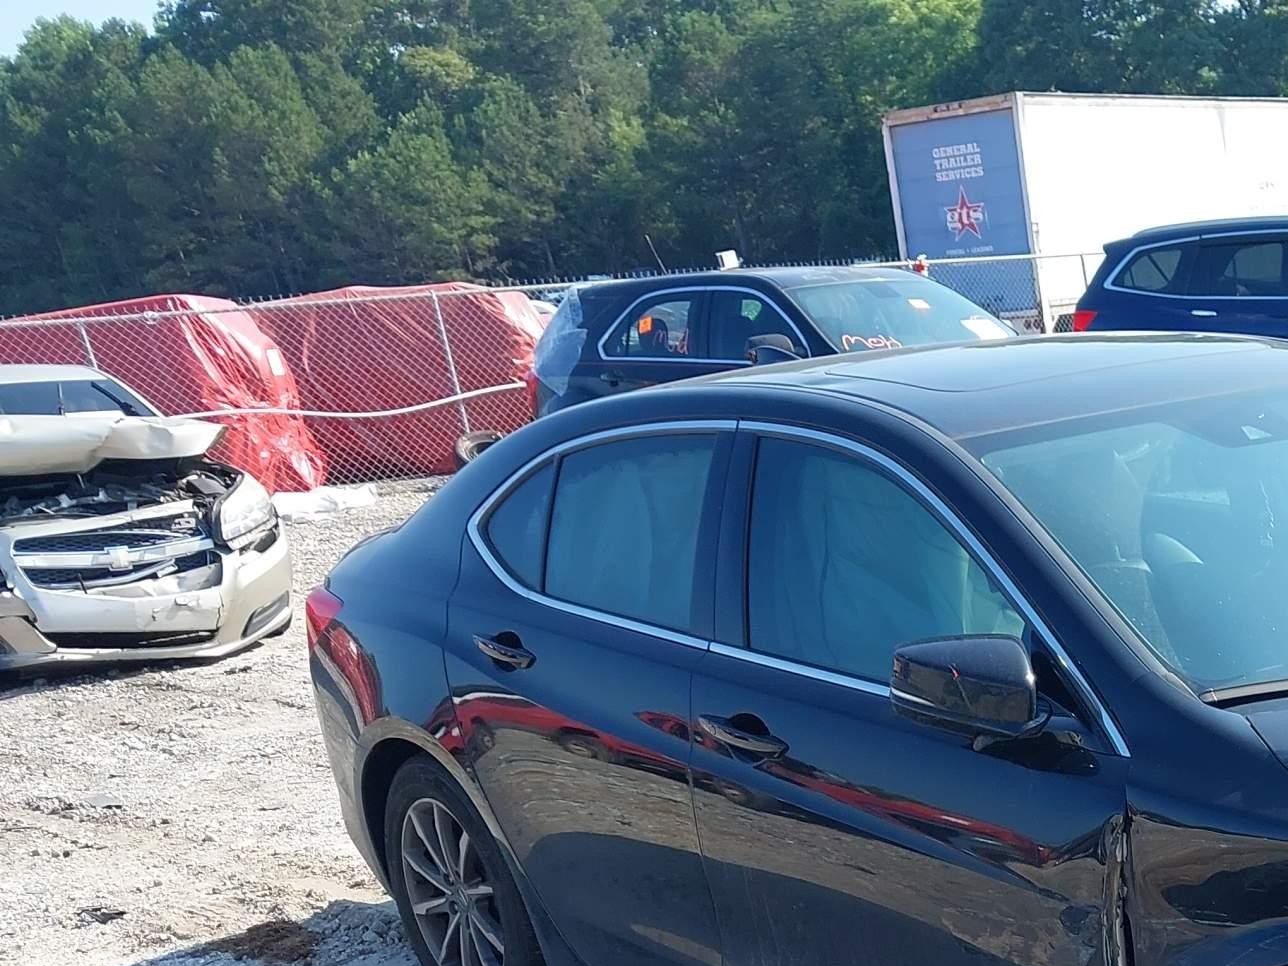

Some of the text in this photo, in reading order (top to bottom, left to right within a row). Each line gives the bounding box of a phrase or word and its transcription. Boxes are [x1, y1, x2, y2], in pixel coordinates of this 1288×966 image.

[932, 142, 981, 158] GENERAL
[934, 154, 982, 170] TRAILER
[935, 166, 984, 182] SERVICES
